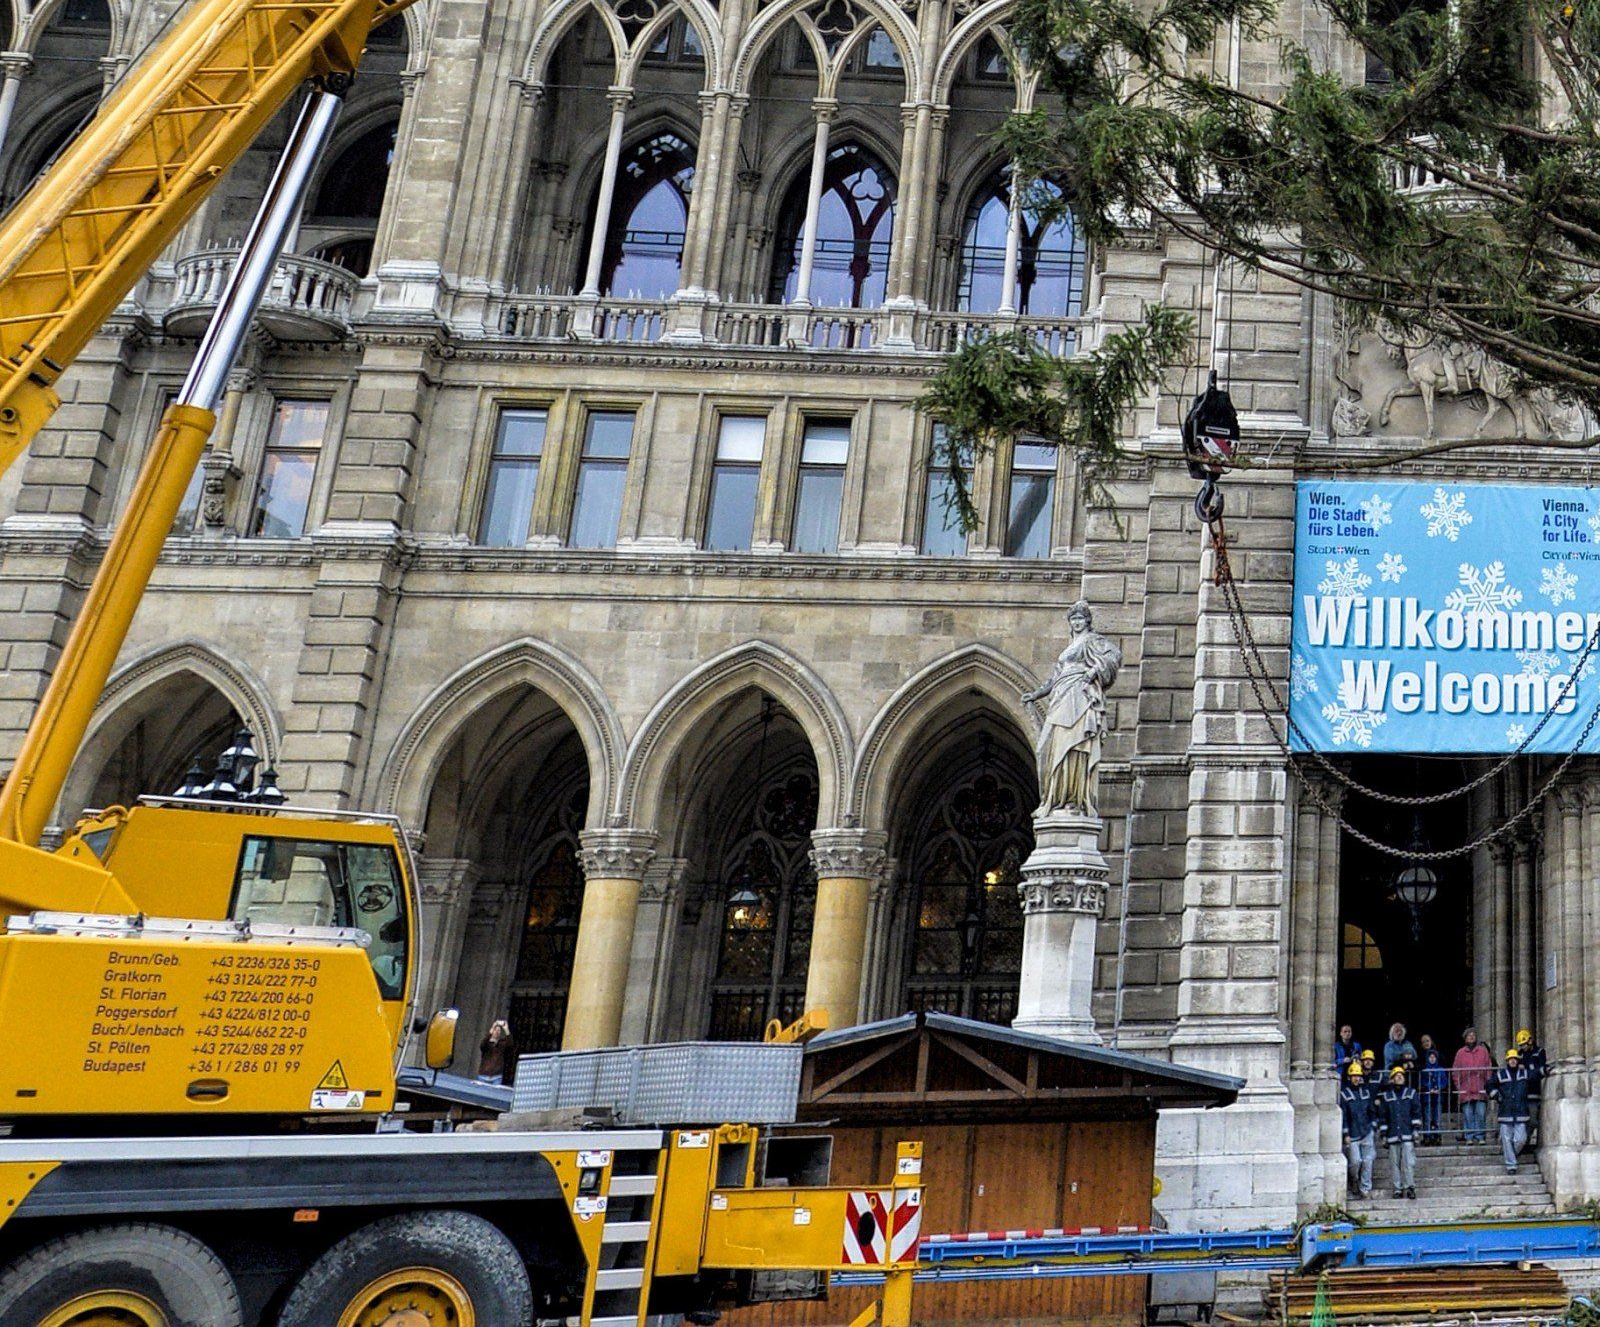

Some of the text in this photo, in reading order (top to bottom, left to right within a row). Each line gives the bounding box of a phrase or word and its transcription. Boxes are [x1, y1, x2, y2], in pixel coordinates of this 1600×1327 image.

[1309, 491, 1346, 506] Wien.
[1542, 498, 1589, 513] Vienna.
[1308, 507, 1366, 522] Die Stadt
[1542, 514, 1579, 530] A City
[1308, 522, 1380, 538] fürs Leben.
[1542, 529, 1592, 543] for Life.
[1340, 659, 1579, 715] Welcome
[211, 956, 234, 968] +43
[236, 956, 291, 970] 2236/326
[293, 958, 320, 971] 35-0
[104, 969, 317, 987] Gratkorn +43 3124/222 77-0
[120, 987, 167, 1001] Florian
[203, 990, 227, 1002] +43
[229, 990, 284, 1004] 7224/200
[286, 992, 314, 1005] 66-0
[95, 1005, 311, 1021] Poggersdorf +43 4224/812 00-0
[91, 1022, 307, 1039] Buch/Jenbach +43 5244/662 22-0
[108, 1041, 151, 1054] Pölten
[192, 1042, 216, 1055] +43
[270, 1043, 287, 1056] 28
[289, 1044, 304, 1056] 97
[83, 1059, 146, 1075] Budapest
[233, 1061, 258, 1073] 286
[263, 1061, 278, 1073] 01
[284, 1061, 301, 1073] 99
[911, 1191, 918, 1203] 4
